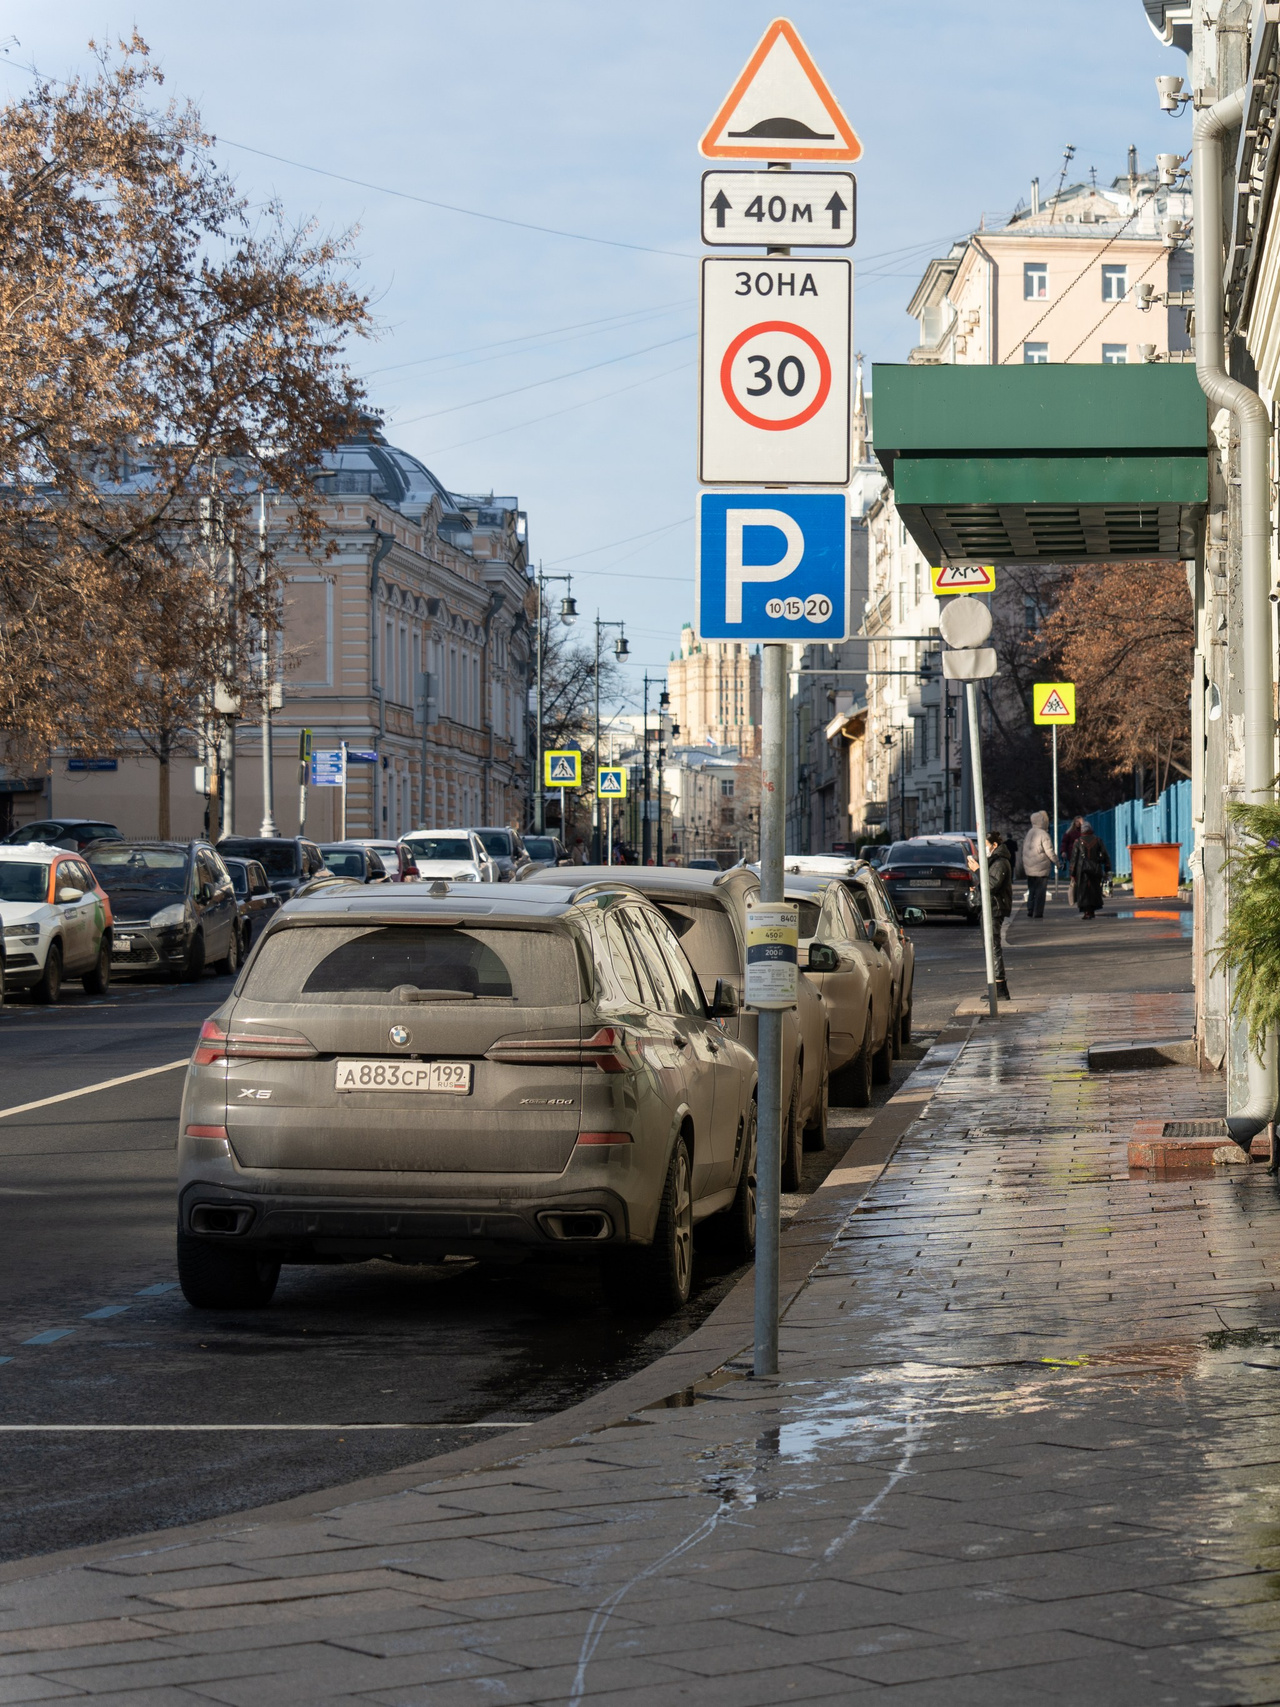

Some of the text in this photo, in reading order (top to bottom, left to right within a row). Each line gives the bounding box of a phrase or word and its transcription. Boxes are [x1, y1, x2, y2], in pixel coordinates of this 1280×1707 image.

[734, 271, 819, 297] ЗОНА
[746, 354, 806, 397] 30
[725, 508, 805, 624] P
[769, 599, 830, 616] 10 15 20
[780, 914, 797, 923] 8402
[432, 1065, 465, 1082] 199
[236, 1088, 274, 1099] X5
